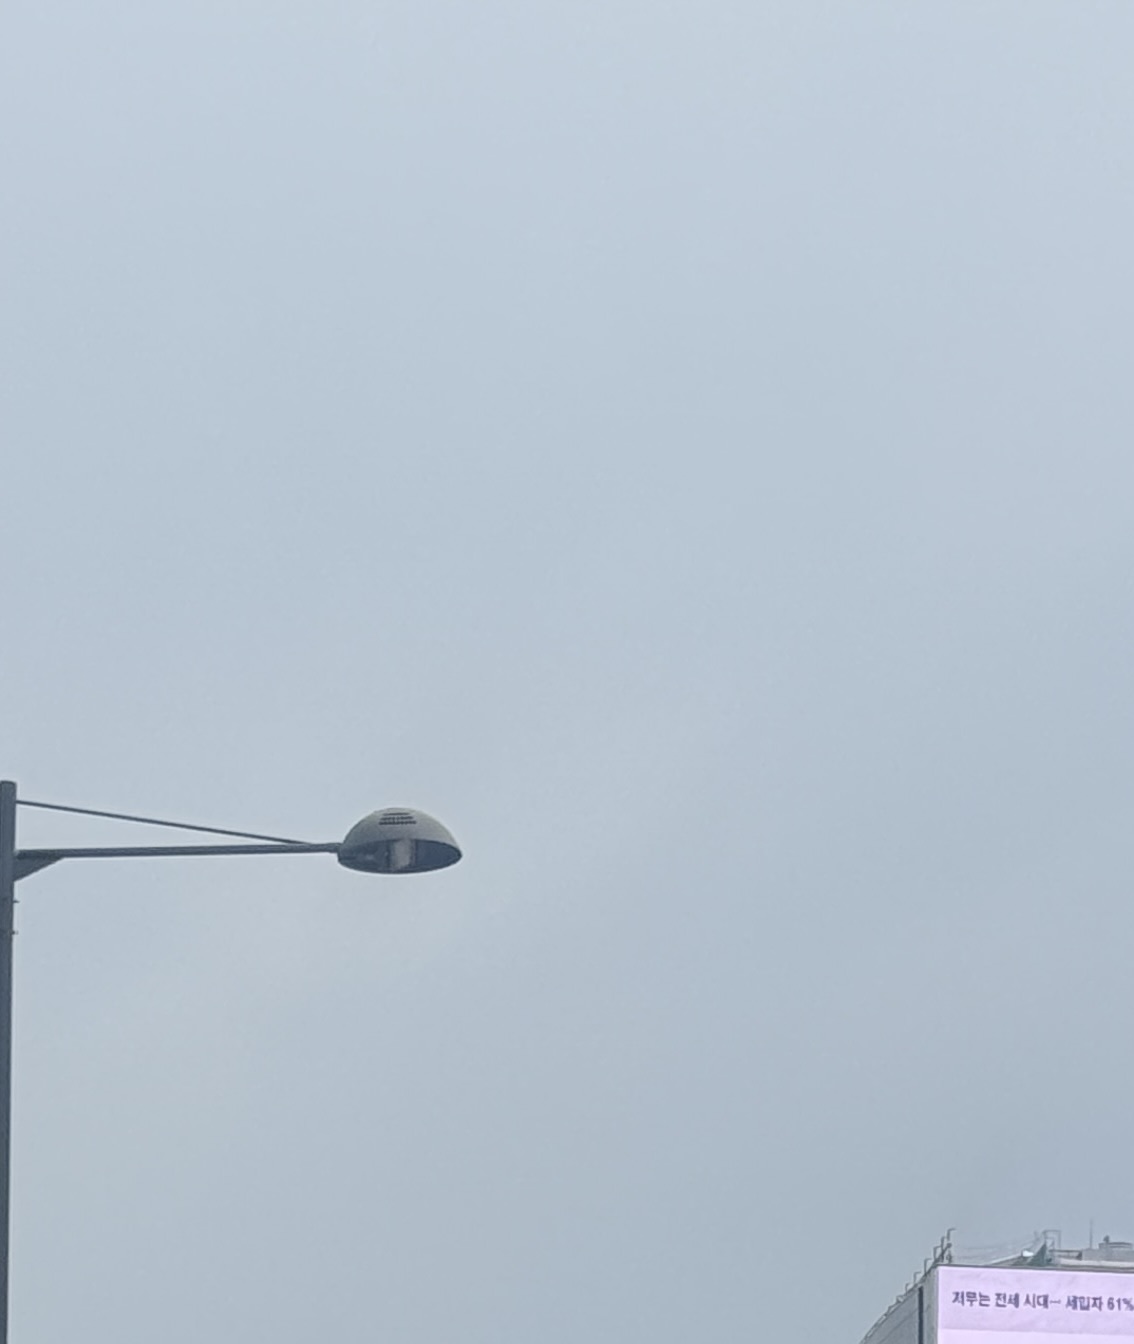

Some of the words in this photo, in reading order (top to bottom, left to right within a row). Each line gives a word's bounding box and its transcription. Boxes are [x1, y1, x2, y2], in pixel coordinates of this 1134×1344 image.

[995, 1292, 1020, 1308] 전세
[1066, 1295, 1104, 1311] 세입자
[1107, 1297, 1134, 1311] 61%
